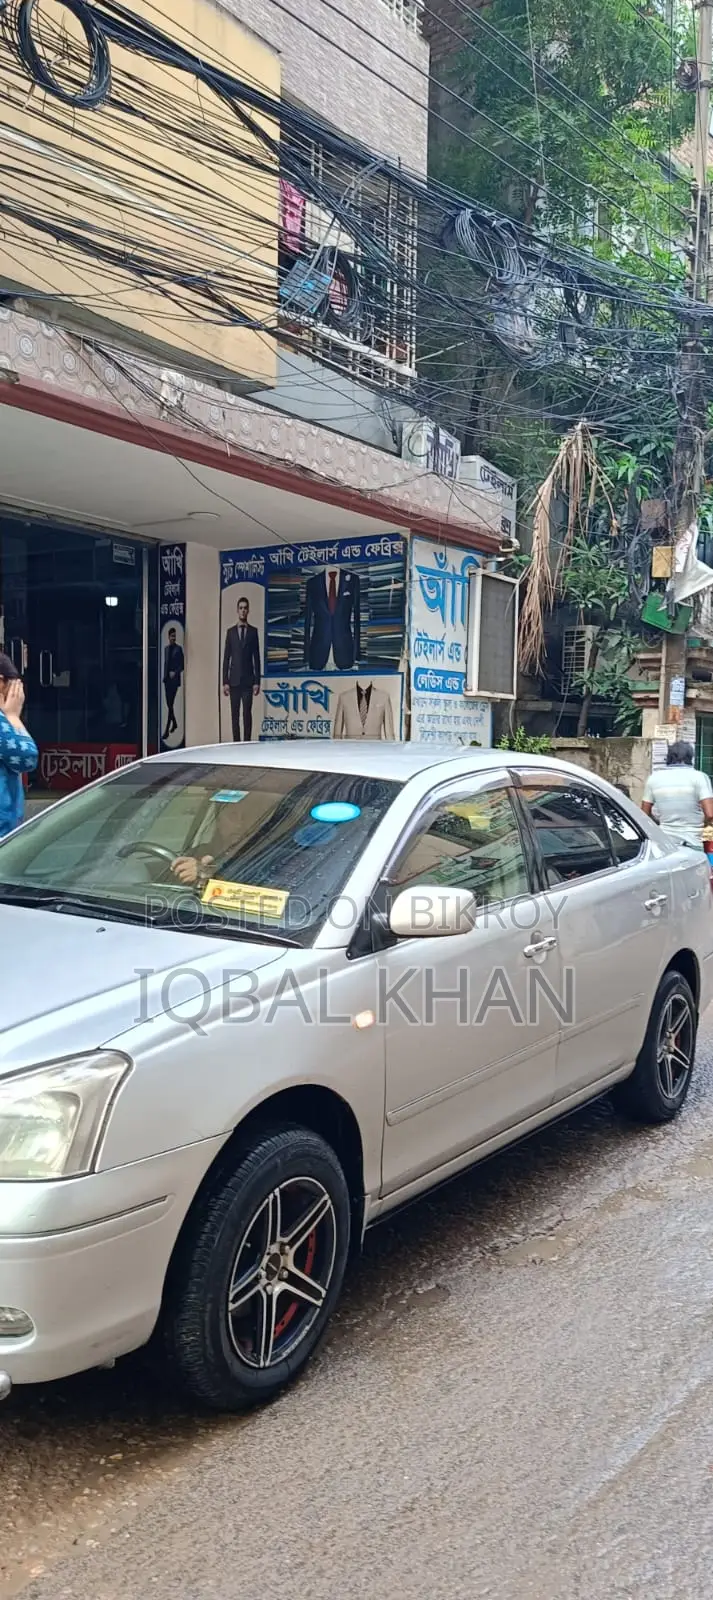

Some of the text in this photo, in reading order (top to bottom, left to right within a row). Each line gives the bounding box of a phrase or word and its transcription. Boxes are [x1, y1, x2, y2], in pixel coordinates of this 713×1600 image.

[162, 546, 184, 576] আঁখি
[269, 537, 404, 566] আঁখি টেইলার্স এন্ড ফেব্রিক্স
[413, 628, 462, 664] টেইলার্স এন্ড
[417, 670, 461, 691] লেডিস এন্ড
[262, 680, 334, 714] আঁখি
[262, 713, 332, 735] টেইলার্স এন্ড ফেব্রিক্স
[41, 746, 107, 781] টেইলার্স
